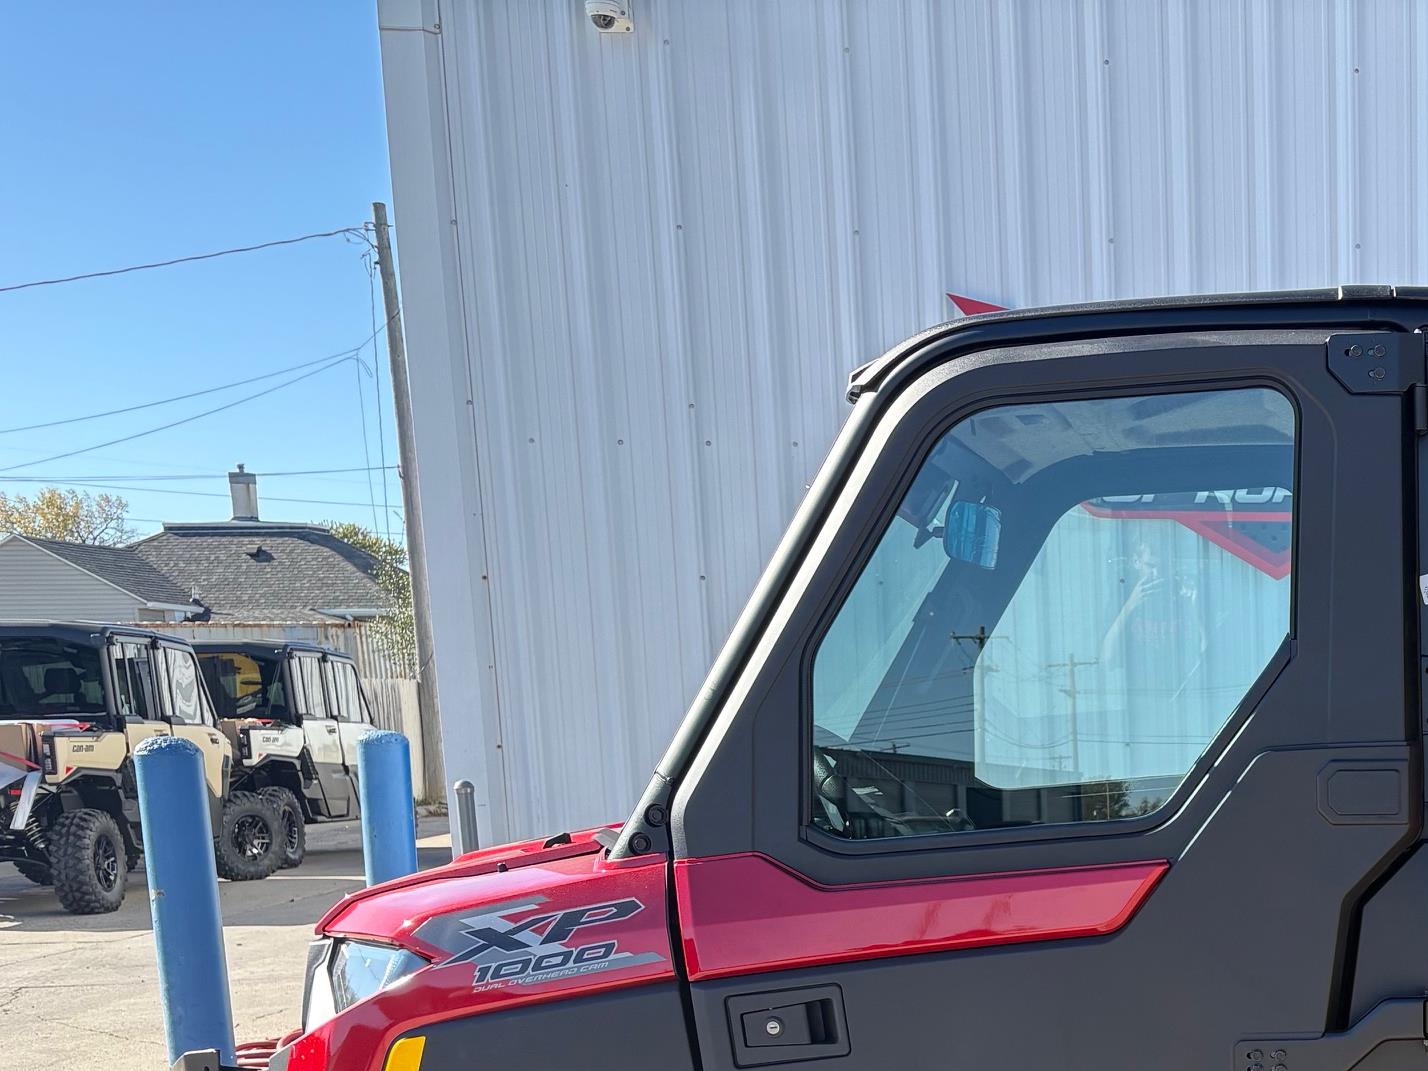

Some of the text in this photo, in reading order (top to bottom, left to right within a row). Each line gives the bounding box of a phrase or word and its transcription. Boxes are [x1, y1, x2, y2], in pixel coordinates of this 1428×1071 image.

[433, 896, 646, 969] XP
[472, 940, 618, 986] 1000
[473, 961, 609, 993] DUAL OVERHEAD CAM
